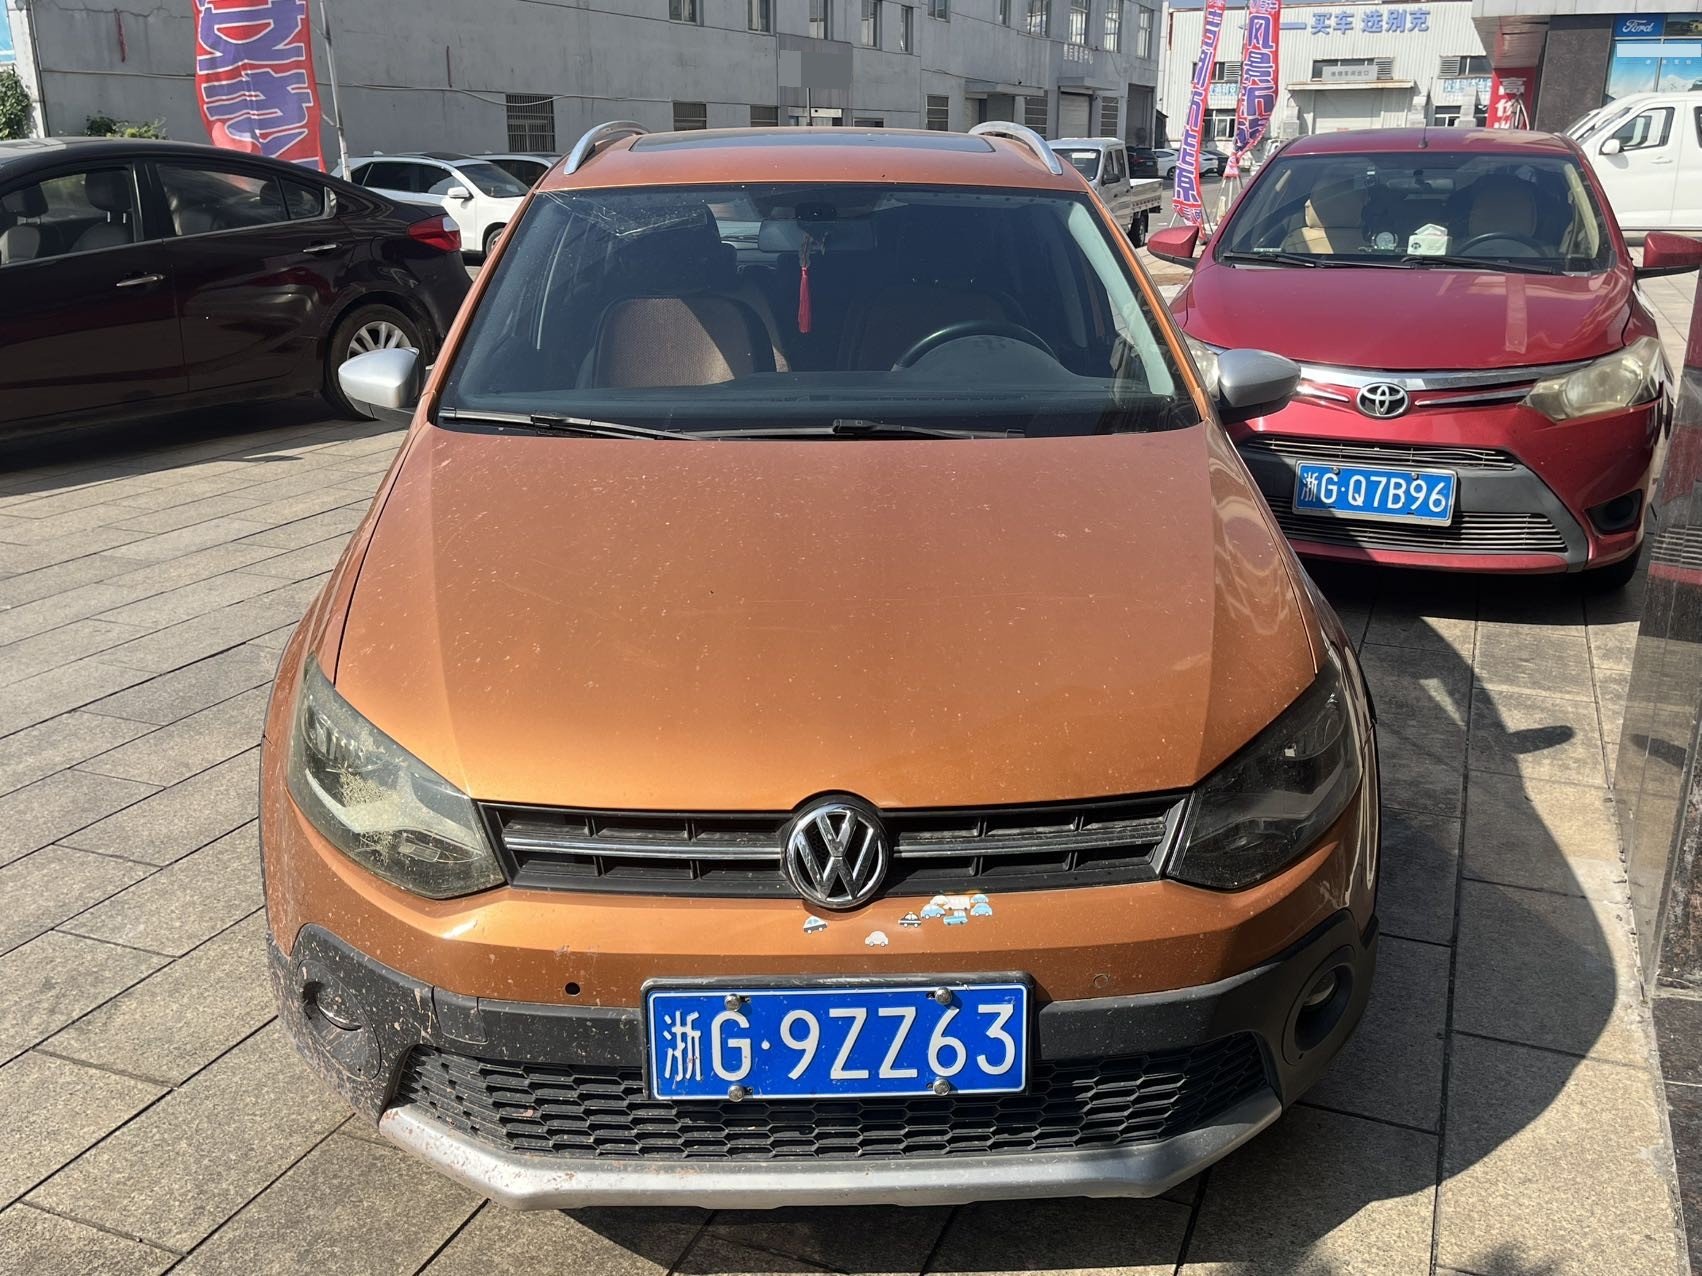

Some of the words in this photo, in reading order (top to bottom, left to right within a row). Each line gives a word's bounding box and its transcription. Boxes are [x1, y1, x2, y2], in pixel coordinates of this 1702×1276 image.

[1311, 12, 1355, 35] 买车
[1362, 8, 1431, 33] 选别克
[1622, 19, 1655, 33] Ford
[1301, 471, 1447, 513] 浙G·Q7B96
[663, 1002, 1017, 1082] 浙G·9ZZ63
